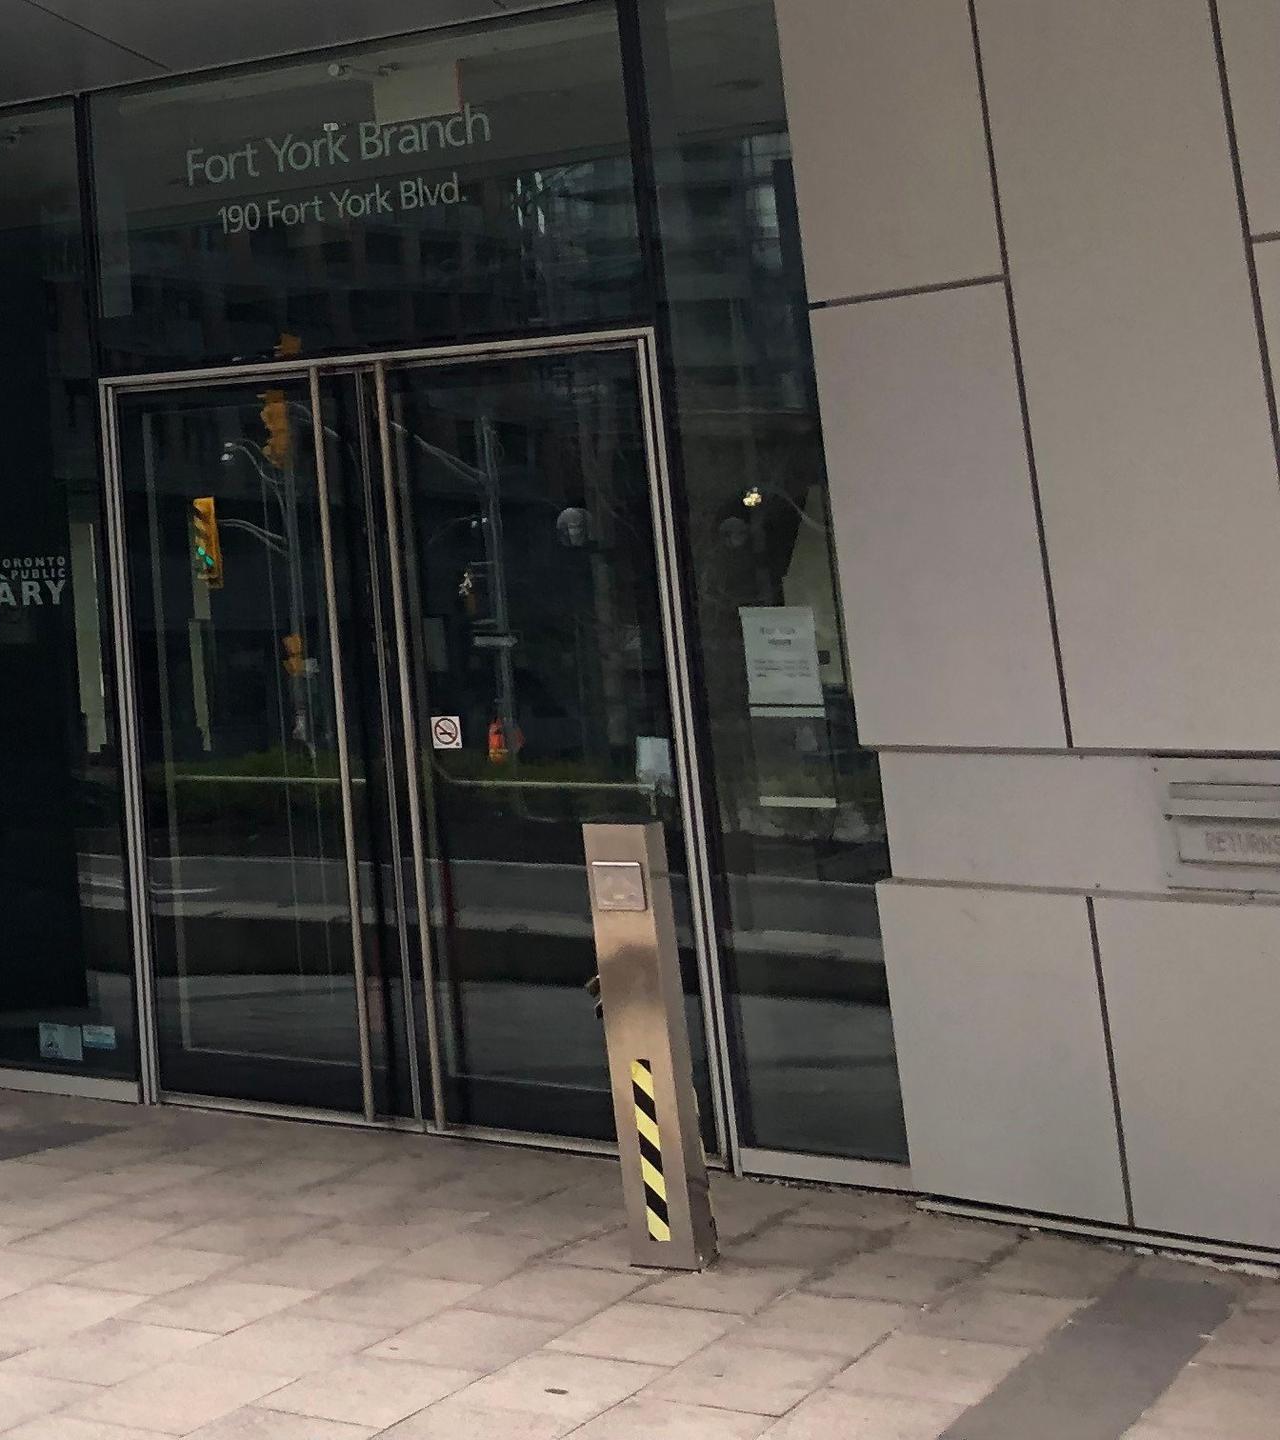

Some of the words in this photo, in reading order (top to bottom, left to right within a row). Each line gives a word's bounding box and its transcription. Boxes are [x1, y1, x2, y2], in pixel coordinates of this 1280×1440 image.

[186, 143, 260, 187] Fort
[265, 130, 351, 173] York
[358, 102, 492, 161] Branch
[218, 202, 262, 235] 190
[266, 195, 326, 229] Fort
[329, 184, 394, 219] York
[399, 171, 468, 211] Blvd.
[10, 568, 67, 580] PUBLIC
